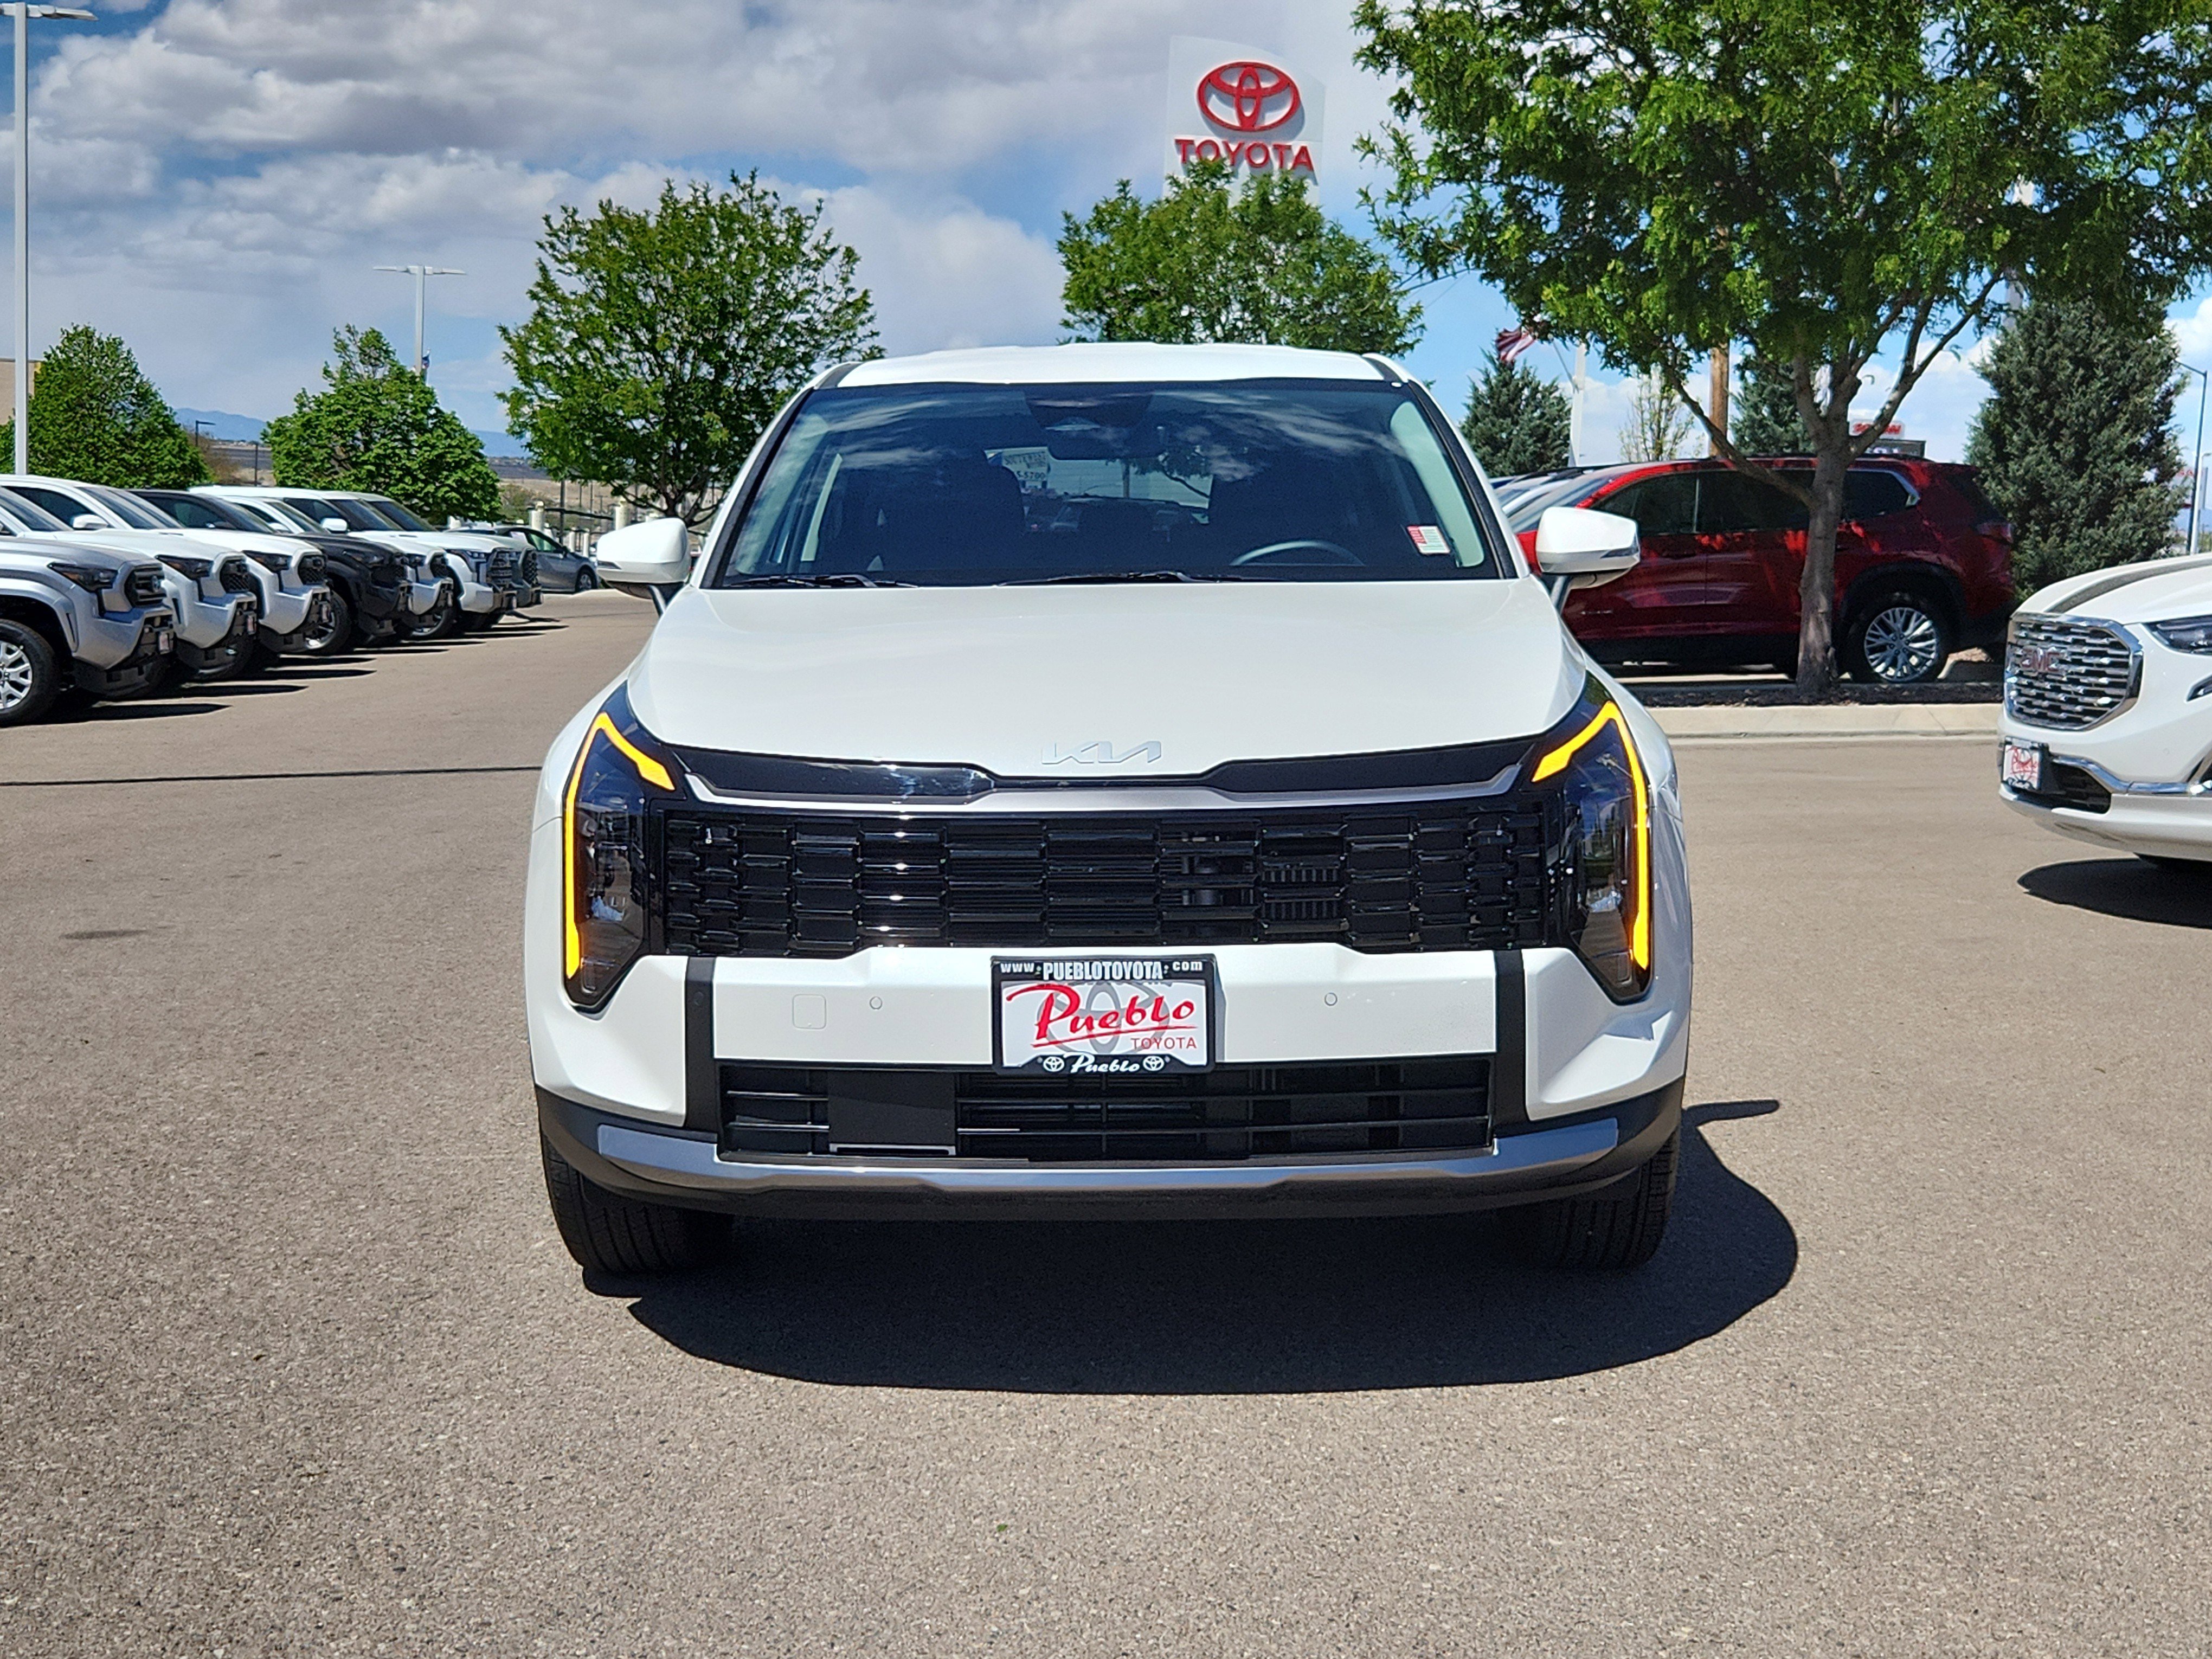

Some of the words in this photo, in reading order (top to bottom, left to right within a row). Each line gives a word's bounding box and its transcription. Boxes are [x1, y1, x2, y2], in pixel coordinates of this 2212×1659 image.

[1174, 139, 1314, 172] TOYOTA
[1041, 741, 1162, 765] KIA
[1006, 982, 1195, 1041] Pueblo
[1131, 1037, 1197, 1050] TOYOTA
[1063, 1052, 1140, 1074] Pueblo
